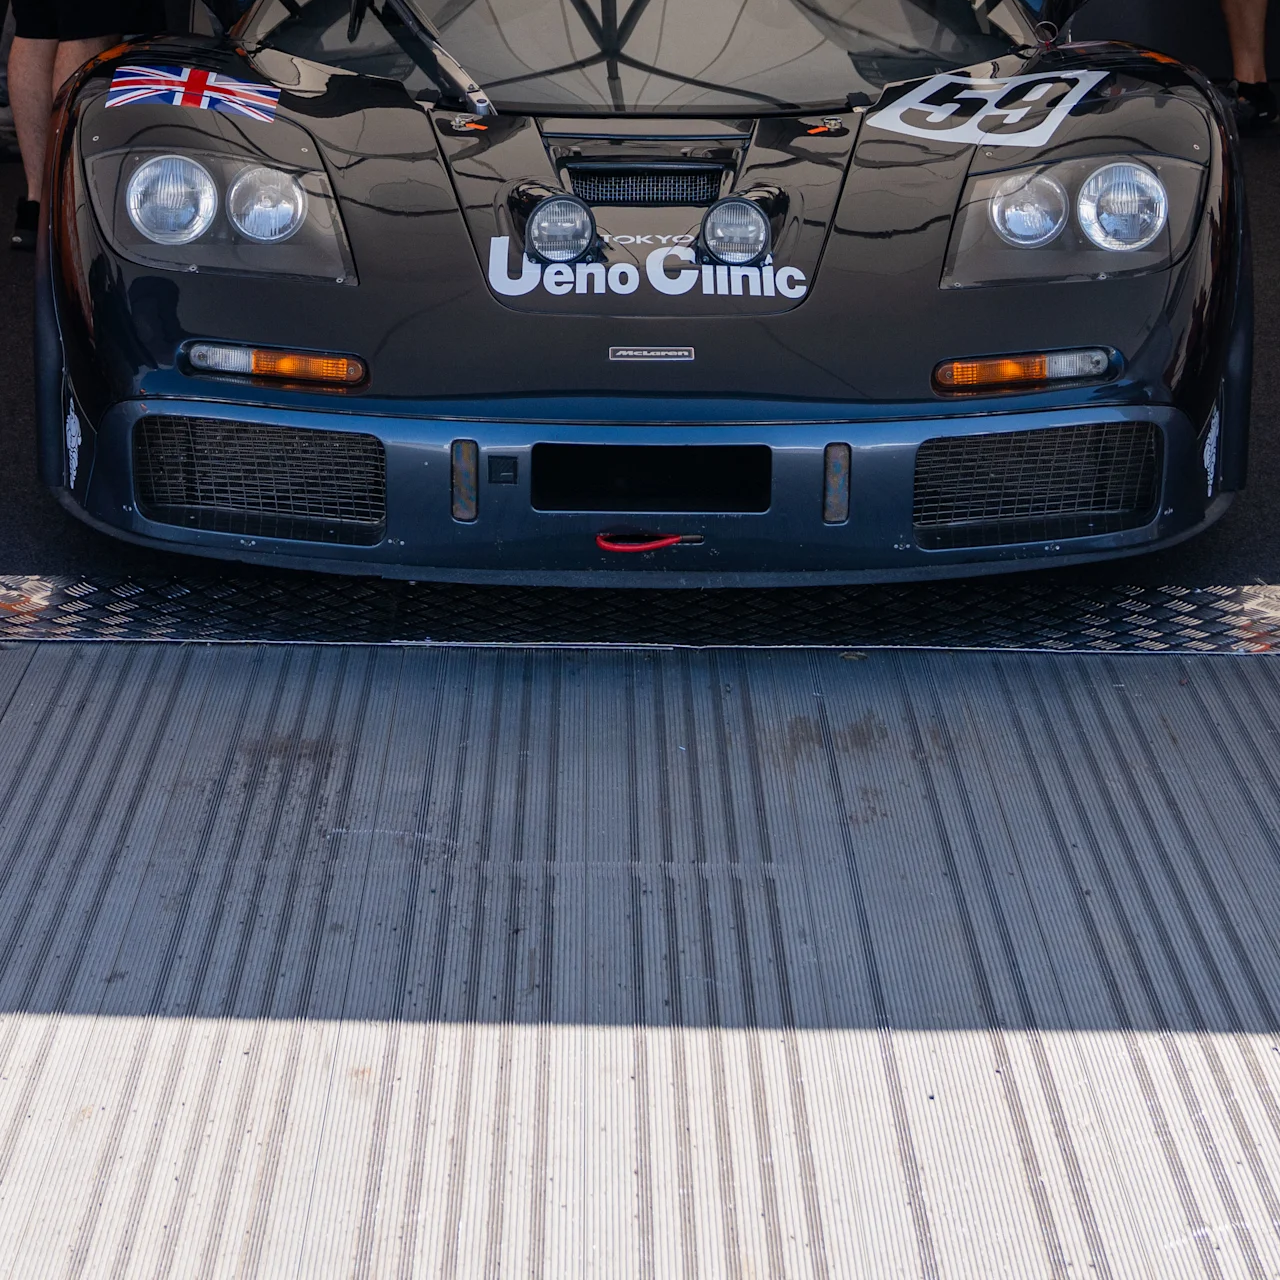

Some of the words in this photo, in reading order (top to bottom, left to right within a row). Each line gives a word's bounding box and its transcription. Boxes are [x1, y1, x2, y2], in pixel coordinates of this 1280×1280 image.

[899, 76, 1081, 135] 59
[488, 236, 640, 297] Ueno
[645, 245, 808, 299] Clinic
[599, 234, 695, 244] TOKYO
